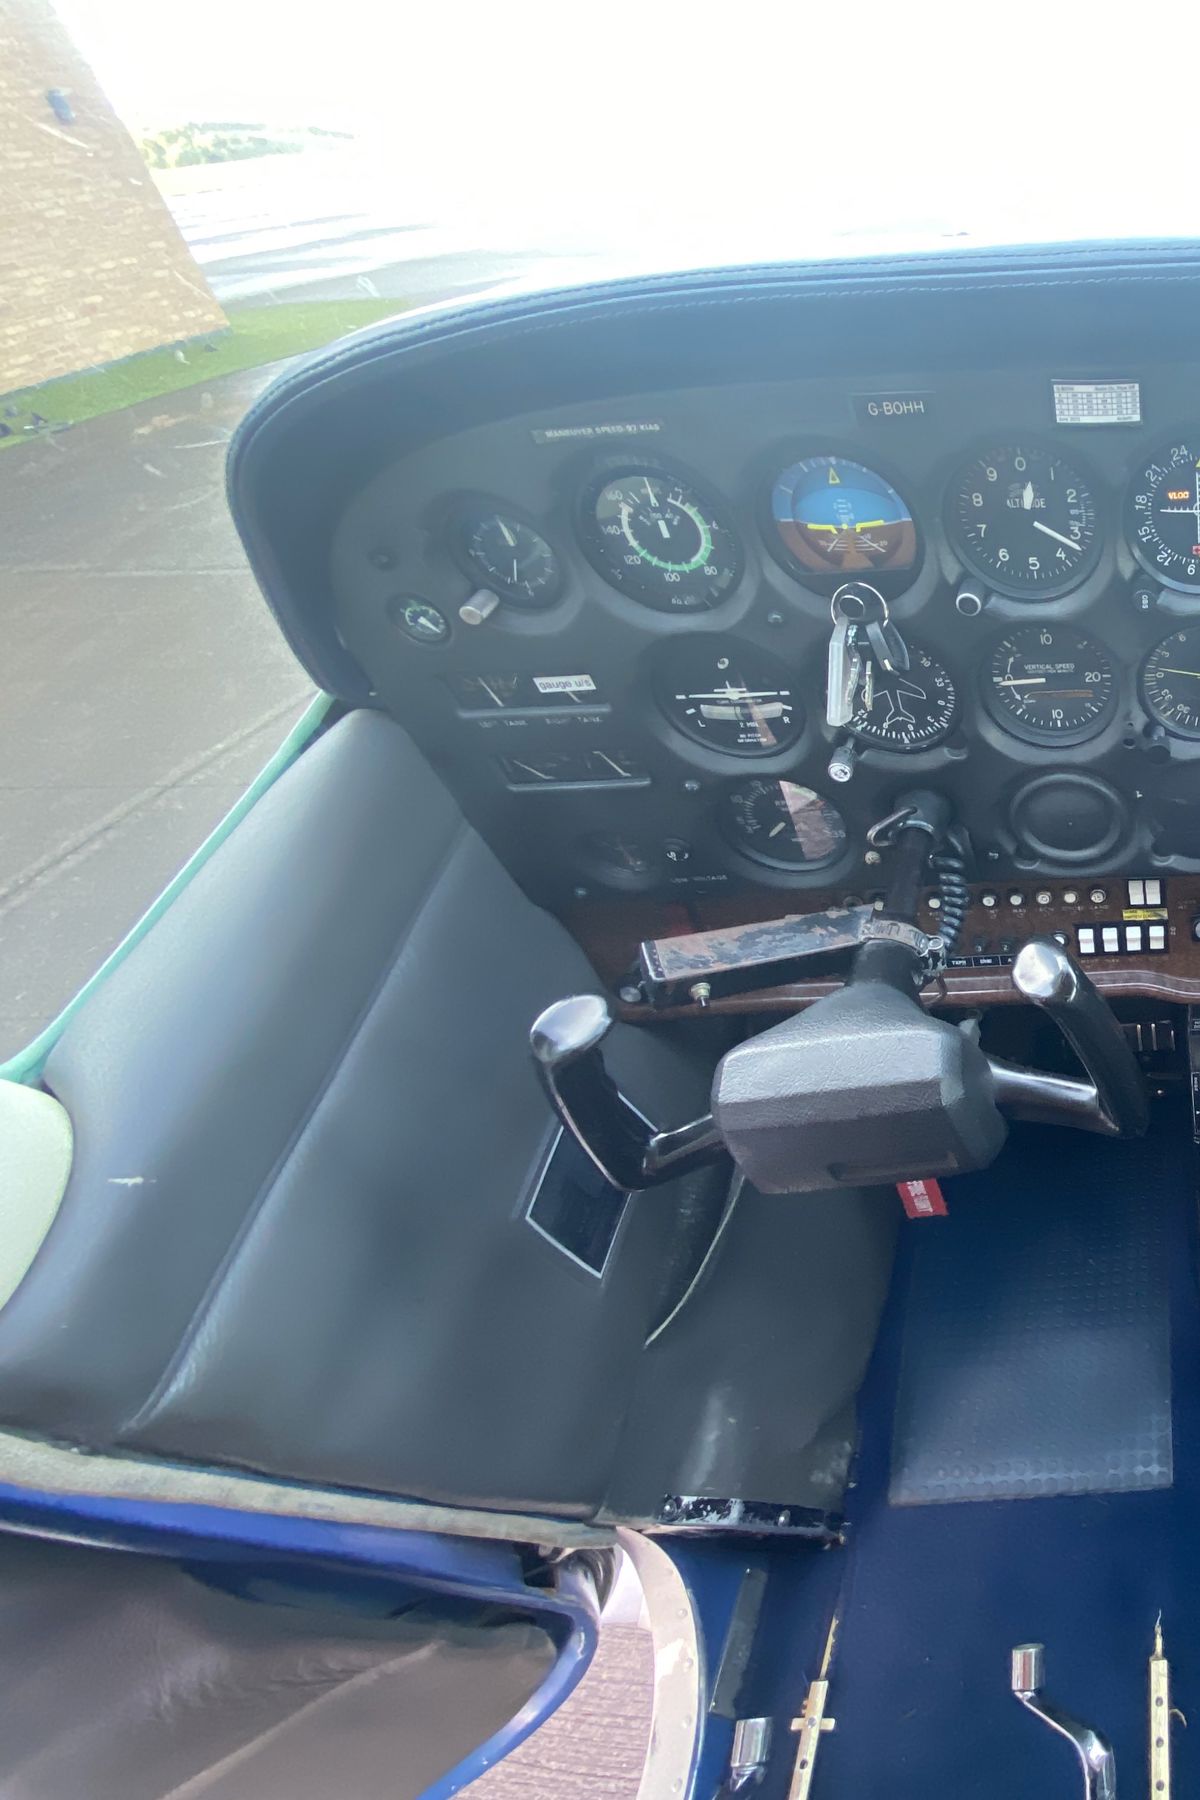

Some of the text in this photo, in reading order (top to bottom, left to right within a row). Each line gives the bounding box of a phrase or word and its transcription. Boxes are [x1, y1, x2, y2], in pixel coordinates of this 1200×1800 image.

[867, 401, 925, 416] G-BOHH
[1171, 444, 1188, 461] 24
[1015, 457, 1026, 471] 0
[986, 467, 998, 481] 9
[1145, 463, 1162, 482] 21
[971, 493, 983, 507] 8
[1066, 489, 1077, 503] 2
[1168, 491, 1189, 500] VLOC
[1006, 498, 1046, 508] ALTIDE
[1135, 495, 1148, 510] 18
[977, 524, 987, 538] 7
[1070, 527, 1081, 540] 3
[623, 555, 642, 566] 120
[998, 548, 1010, 561] 6
[1055, 547, 1066, 561] 4
[1029, 556, 1040, 570] 5
[663, 572, 681, 582] 100
[704, 566, 718, 576] 80
[1040, 633, 1053, 645] 10
[1084, 671, 1101, 683] 20
[538, 680, 573, 690] gauge
[782, 716, 791, 724] R
[1052, 708, 1063, 720] 10
